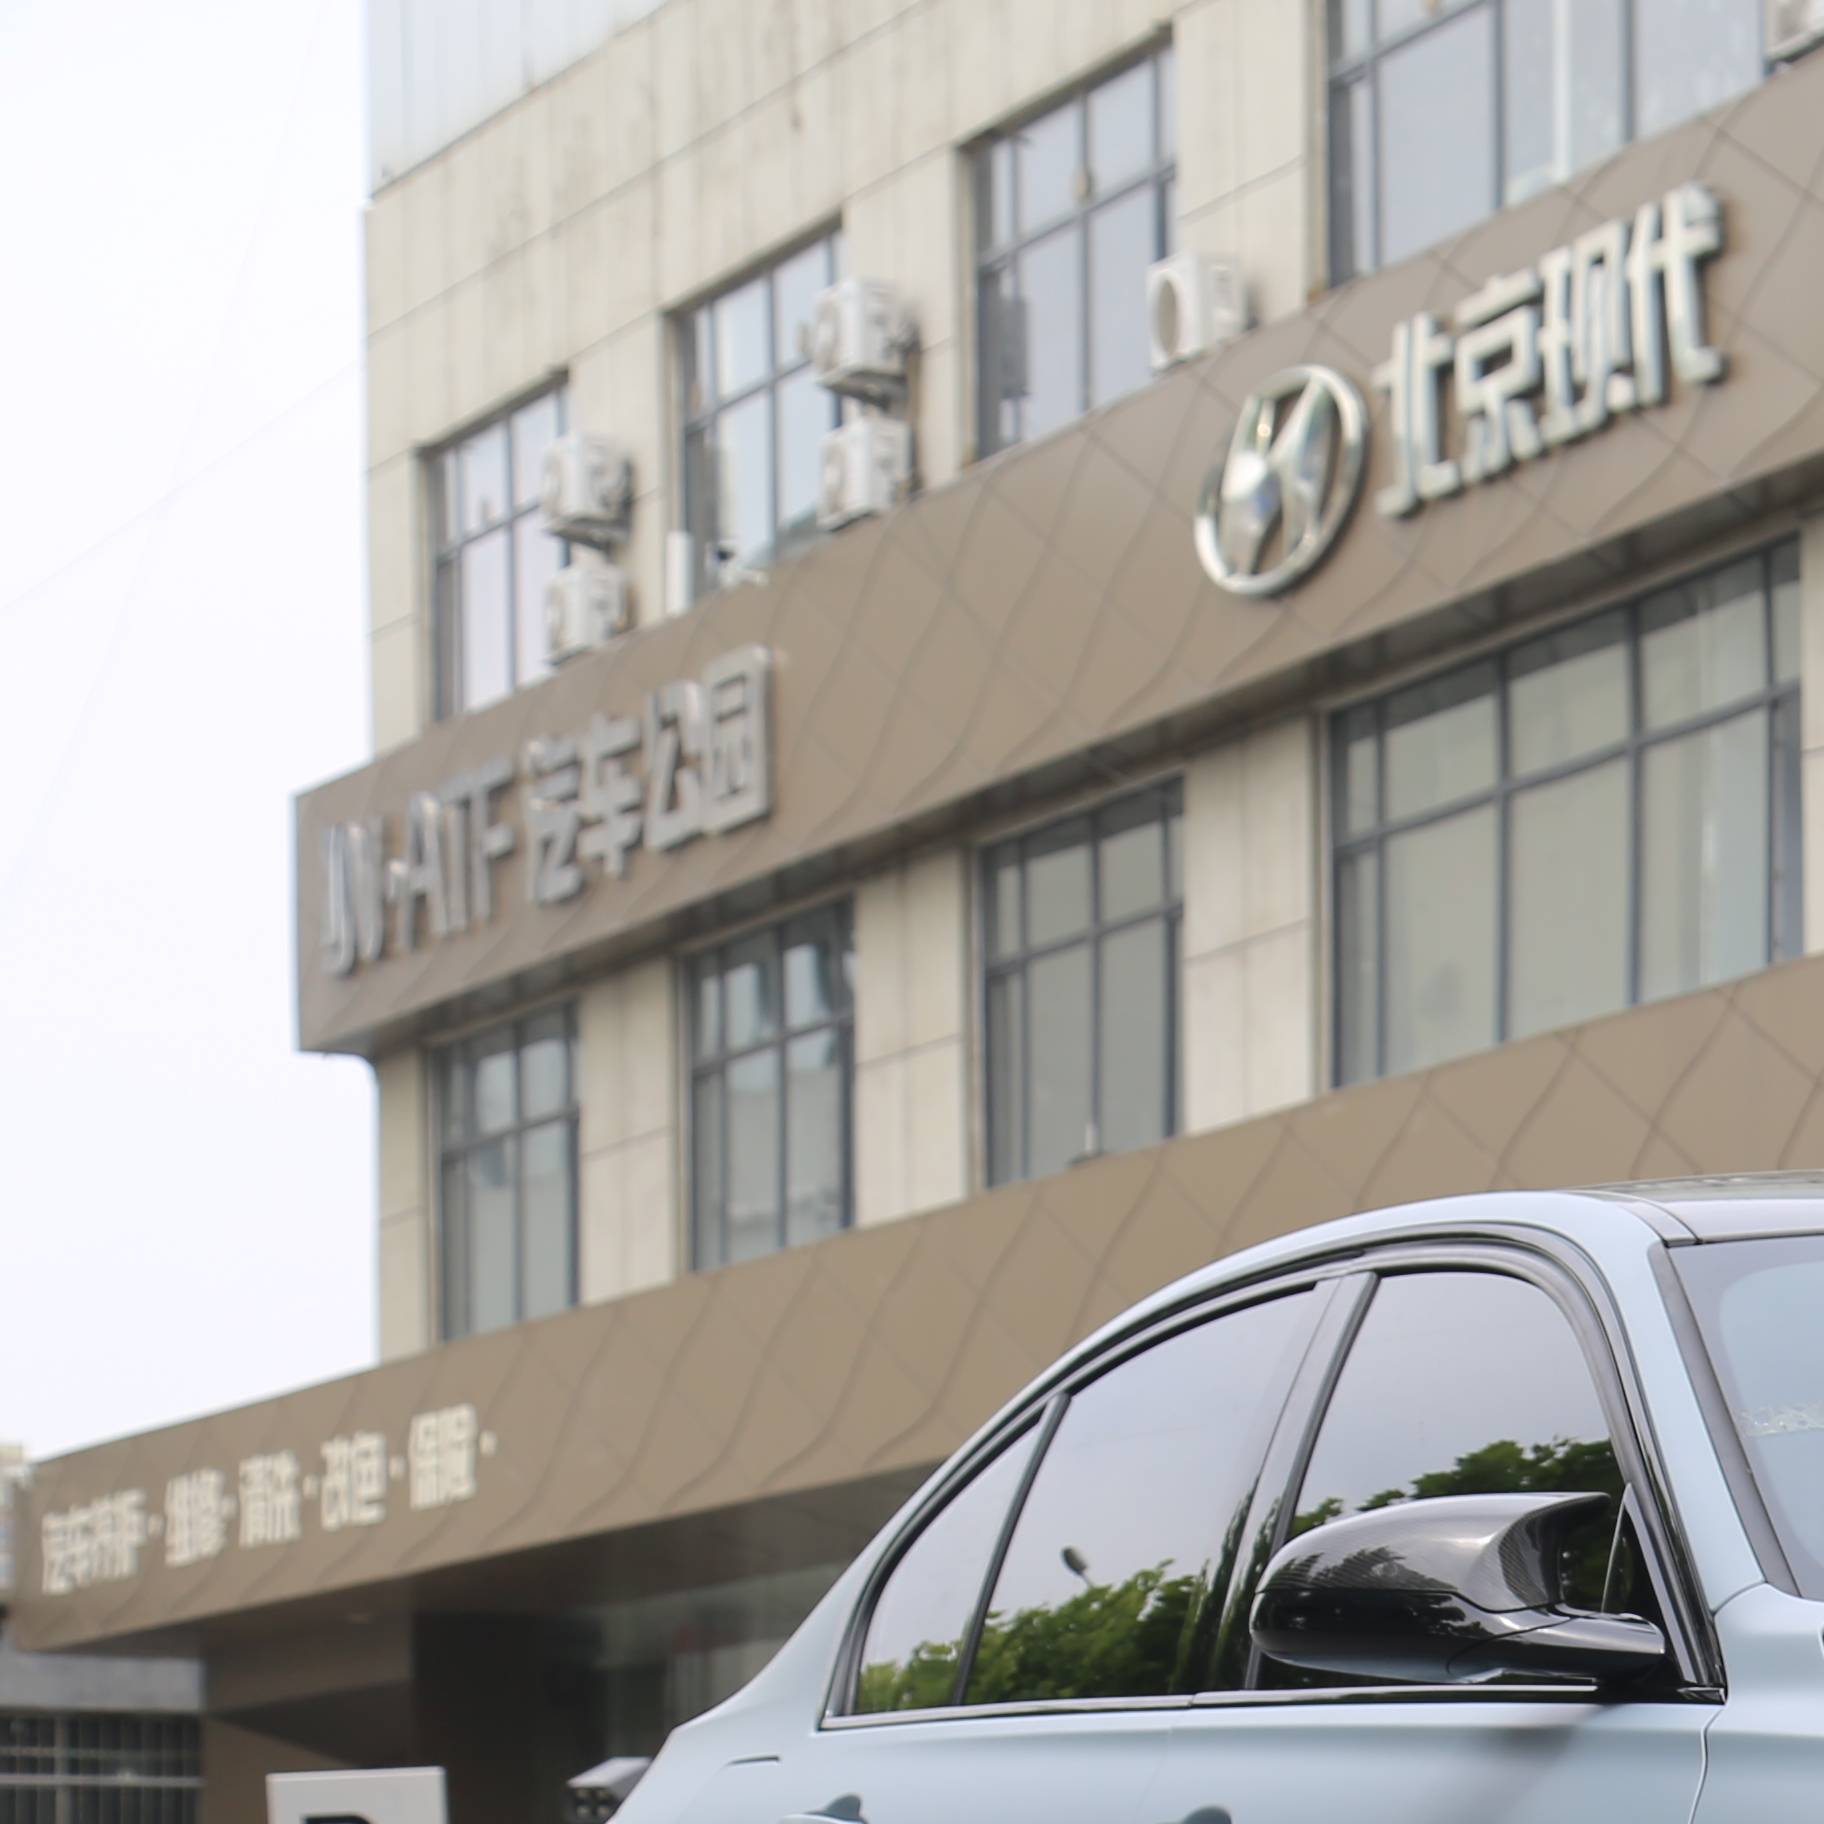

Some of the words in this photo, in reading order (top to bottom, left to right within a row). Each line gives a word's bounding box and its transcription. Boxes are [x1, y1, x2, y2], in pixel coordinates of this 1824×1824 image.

[1372, 182, 1728, 518] 北京现代
[522, 642, 775, 908] 汽车公园
